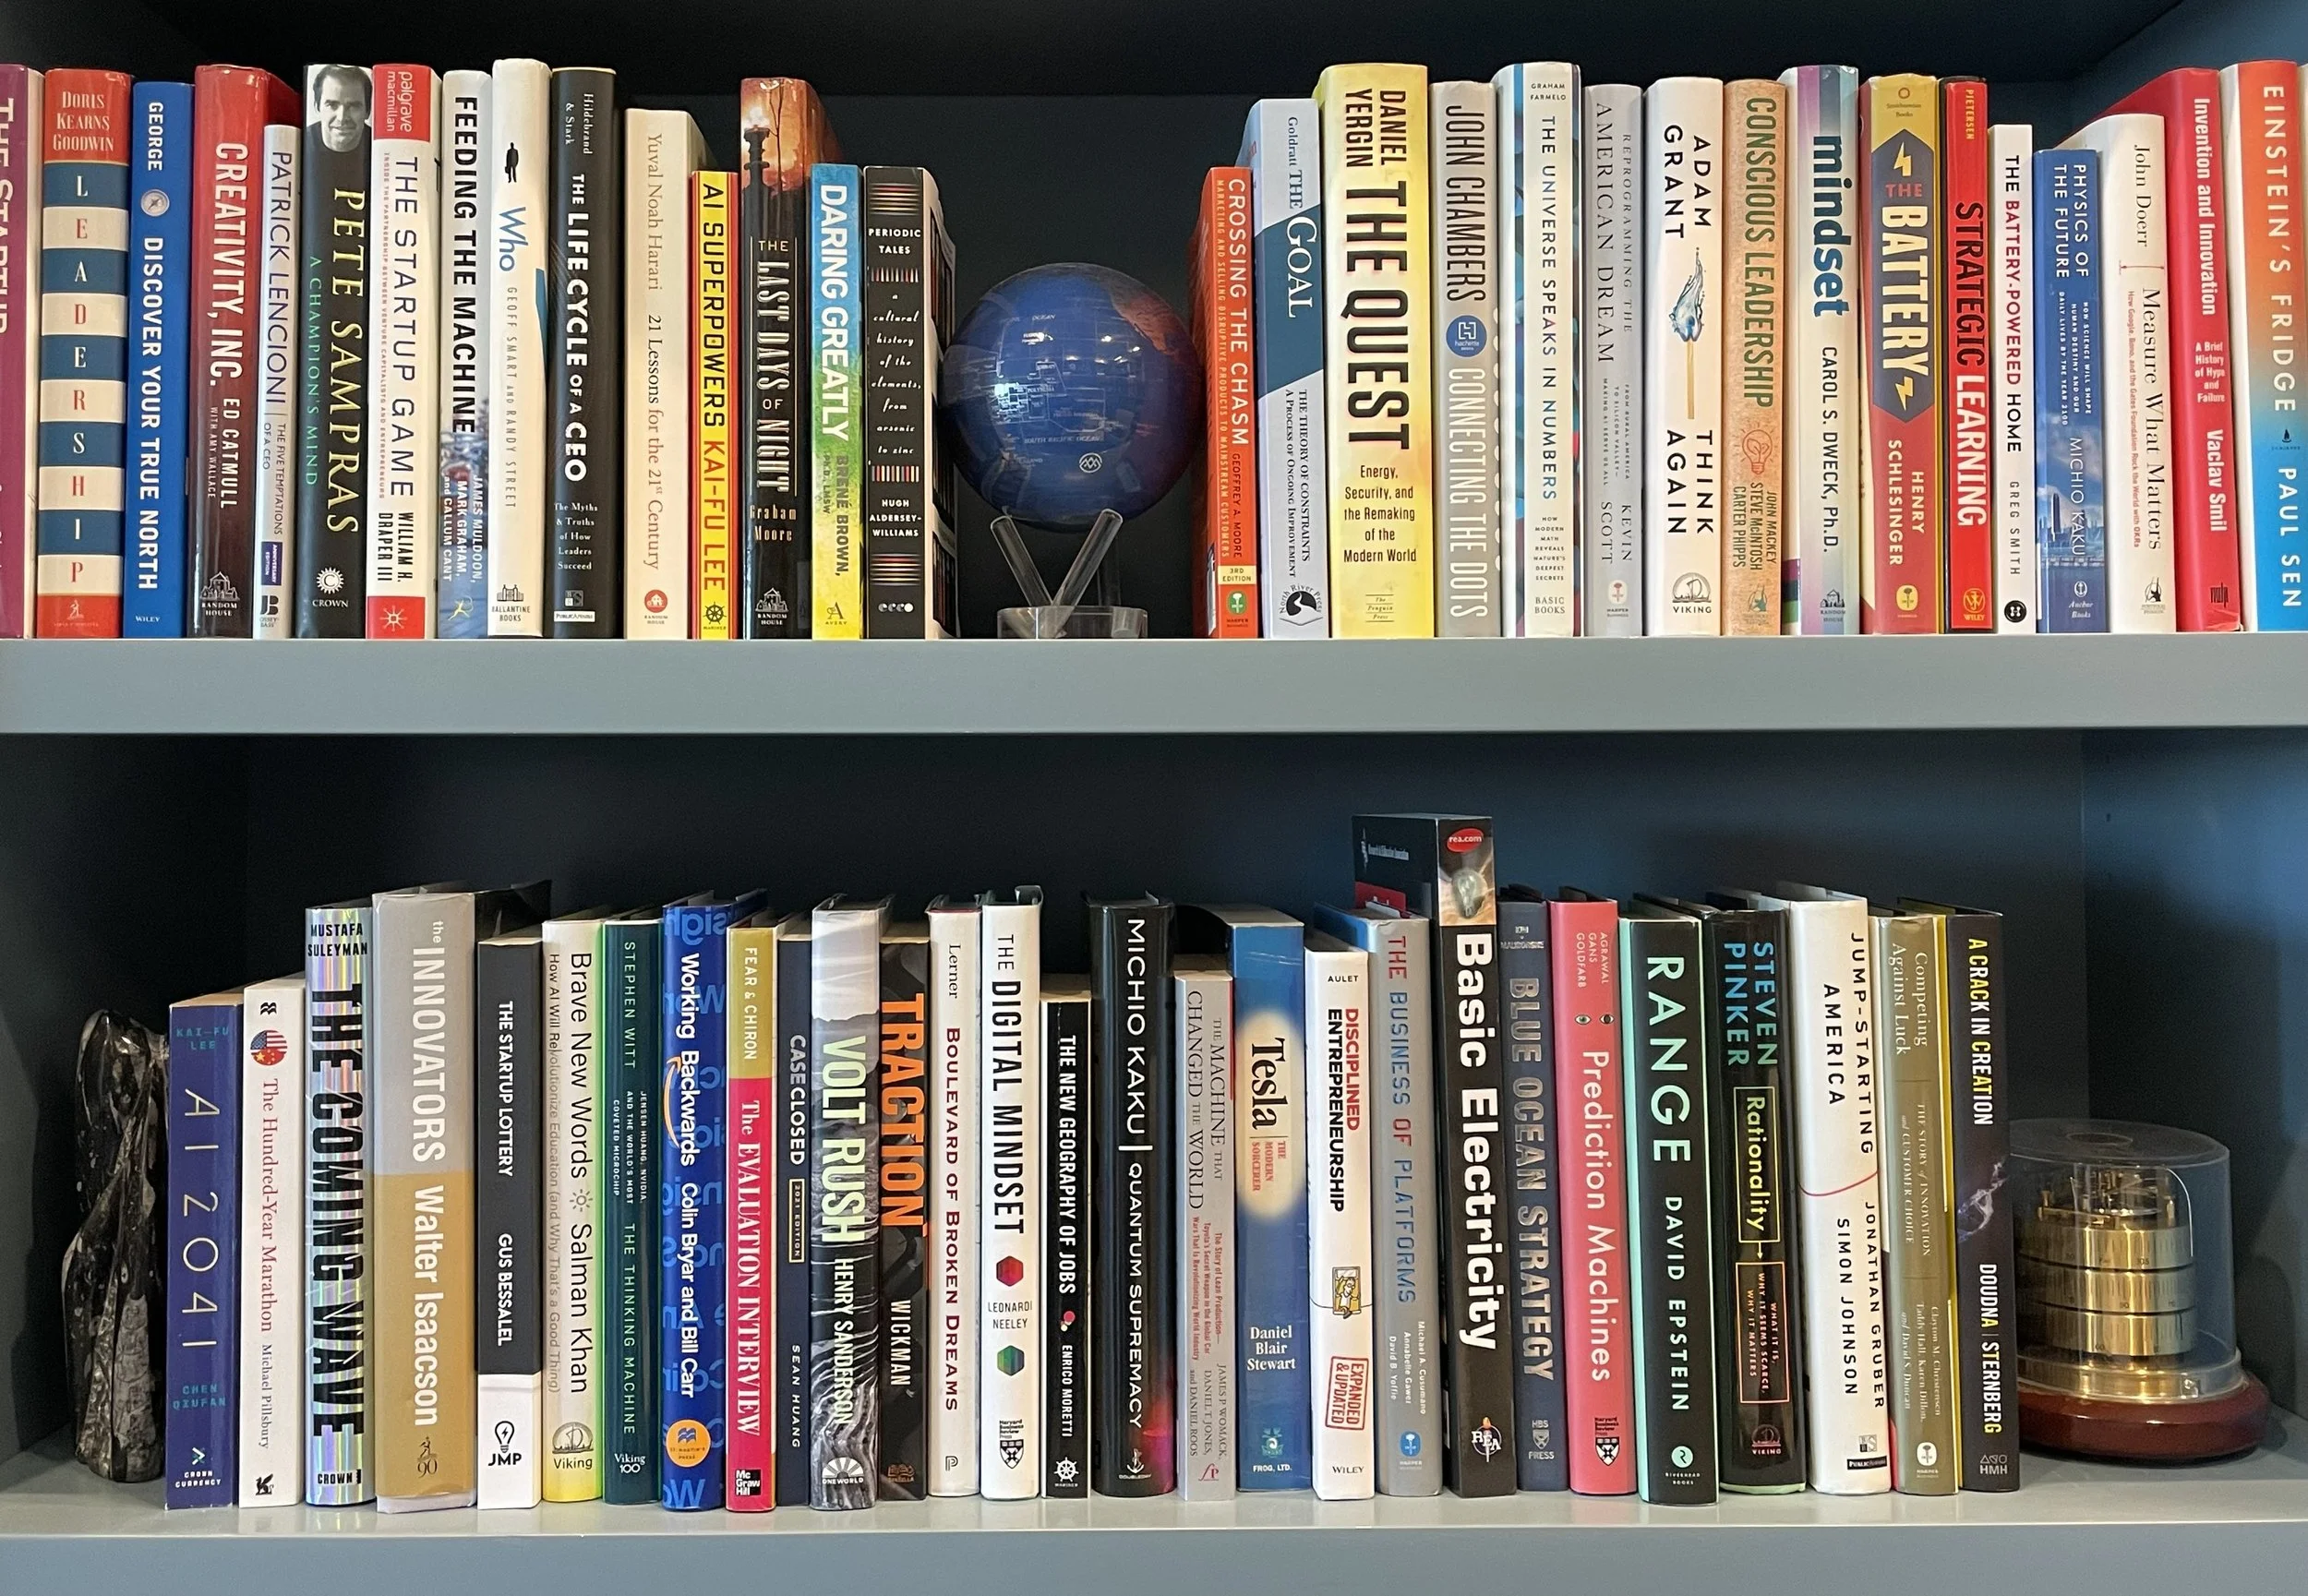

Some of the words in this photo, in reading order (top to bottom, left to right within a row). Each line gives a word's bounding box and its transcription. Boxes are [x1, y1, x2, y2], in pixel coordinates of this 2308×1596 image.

[57, 113, 109, 131] KEARNS
[63, 91, 104, 108] DORIS
[149, 102, 163, 170] GEORGE
[387, 71, 397, 131] macmillan
[397, 72, 415, 132] palgrave
[583, 94, 594, 153] Hildebrand
[1346, 89, 1373, 167] YERGIN
[1380, 90, 1406, 165] DANIEL
[1446, 106, 1485, 164] JOHN
[54, 134, 113, 151] GOODWIN
[454, 98, 477, 218] FEEDING
[648, 134, 663, 177] Yuval
[1289, 117, 1298, 166] Goldratt
[1597, 103, 1613, 249] AMERICAN
[1665, 126, 1684, 238] GRANT
[1694, 136, 1711, 226] ADAM
[1745, 98, 1776, 242] CONSCIOUS
[2134, 145, 2150, 186] John
[2264, 87, 2290, 272] EINSTEIN'S
[270, 152, 292, 260] PATRICK
[396, 157, 417, 213] THE
[572, 174, 584, 204] THE
[648, 185, 663, 228] Noah
[703, 184, 724, 208] AI
[1290, 170, 1303, 209] THE
[1346, 181, 1407, 272] THE
[1814, 136, 1852, 317] mindset
[2137, 197, 2151, 246] Doerr
[208, 143, 247, 318] CREATIVITY,
[310, 257, 321, 268] A
[332, 188, 365, 296] PETE
[454, 230, 475, 284] THE
[499, 207, 528, 271] Who
[568, 213, 588, 270] LIFE
[648, 234, 662, 290] Harari
[822, 186, 847, 298] DARING
[869, 229, 920, 237] PERIODIC
[879, 246, 910, 254] TALES
[1229, 179, 1246, 297] CROSSING
[1287, 217, 1316, 318] GOAL
[1447, 177, 1485, 301] CHAMBERS
[143, 238, 162, 355] DISCOVER
[393, 230, 416, 380] STARTUP
[567, 280, 588, 366] CYCLE
[703, 222, 725, 427] SUPERPOWERS
[1598, 267, 1614, 361] DREAM
[1882, 206, 1929, 376] BATTERY
[1955, 203, 1984, 366] STRATEGIC
[210, 330, 243, 386] INC.
[266, 273, 289, 402] LENCIONI
[307, 278, 321, 414] CHAMPION'S
[453, 297, 475, 432] MACHINE
[1231, 308, 1247, 352] THE
[1340, 290, 1409, 450] QUEST
[1744, 253, 1774, 407] LEADERSHIP
[2272, 295, 2295, 411] FRIDGE
[141, 366, 161, 427] YOUR
[570, 375, 582, 396] OF
[570, 402, 582, 414] A
[822, 307, 848, 440] GREATLY
[1232, 363, 1248, 444] CHASM
[306, 426, 318, 485] MIND
[327, 321, 362, 532] SAMPRAS
[391, 399, 414, 496] GAME
[565, 422, 586, 481] CEO
[1957, 376, 1986, 525] LEARNING
[2207, 429, 2224, 486] Vaclav
[140, 438, 160, 499] TRUE
[703, 439, 725, 532] KAI-FU
[1667, 430, 1687, 533] AGAIN
[1697, 430, 1713, 533] THINK
[2010, 482, 2019, 517] GREG
[2070, 438, 2084, 503] MICHIO
[138, 510, 158, 588] NORTH
[2010, 528, 2020, 574] SMITH
[2071, 510, 2087, 555] KAKU
[2209, 494, 2227, 531] Smil
[704, 545, 725, 590] LEE
[1449, 835, 1483, 844] rea.com
[308, 942, 367, 956] SULEYMAN
[311, 923, 363, 936] MUSTAFA
[433, 921, 443, 942] the
[998, 934, 1014, 970] THE
[1388, 936, 1407, 978] THE
[1969, 939, 1988, 949] A
[625, 942, 635, 1017] STEPHEN
[676, 954, 701, 1038] Working
[949, 945, 960, 998] Lerner
[1127, 919, 1145, 1035] MICHIO
[1457, 934, 1495, 1066] Basic
[1725, 943, 1749, 1065] PINKER
[1754, 942, 1777, 1064] STEVEN
[1888, 943, 1908, 1006] Against
[1912, 953, 1930, 1046] Competing
[1969, 955, 1989, 1012] CRACK
[312, 983, 363, 1072] THE
[413, 948, 445, 1161] INNOVATORS
[625, 1028, 635, 1068] WITT
[992, 981, 1022, 1091] DIGITAL
[1389, 992, 1410, 1104] BUSINESS
[1510, 978, 1541, 1062] BLUE
[1648, 957, 1690, 1161] RANGE
[1824, 984, 1845, 1104] AMERICA
[1895, 1015, 1910, 1054] Luck
[1971, 1018, 1990, 1034] IN
[680, 1051, 700, 1166] Backwards
[823, 1036, 866, 1123] VOLT
[881, 993, 924, 1228] TRACTION
[1127, 1048, 1145, 1134] KAKU
[1252, 1038, 1288, 1129] Tesla
[1328, 1009, 1343, 1211] ENTREPRENEURSHIP
[1346, 1009, 1359, 1130] DISCIPLINED
[1972, 1042, 1992, 1124] CREATION
[742, 1100, 759, 1134] The
[1393, 1119, 1412, 1146] OF
[1513, 1077, 1546, 1189] OCEAN
[1583, 1052, 1613, 1208] Prediction
[313, 1092, 364, 1280] COMING
[821, 1138, 866, 1242] RUSH
[993, 1106, 1024, 1233] MINDSET
[1747, 1098, 1771, 1230] Rationality
[415, 1185, 443, 1282] Walter
[738, 1144, 760, 1287] EVALUATION
[1394, 1160, 1415, 1302] PLATFORMS
[1460, 1088, 1504, 1349] Electricity
[571, 1224, 593, 1316] Salman
[1518, 1206, 1554, 1380] STRATEGY
[1588, 1225, 1618, 1380] Machines
[262, 1345, 272, 1390] Michael
[313, 1300, 364, 1436] WAVE
[415, 1293, 443, 1425] Isaacson
[571, 1328, 593, 1392] Khan
[738, 1297, 760, 1435] INTERVIEW
[1062, 1345, 1072, 1385] ENRICO
[1247, 1359, 1295, 1370] Stewart
[1251, 1326, 1292, 1338] Daniel
[1256, 1341, 1287, 1354] Blair
[258, 1396, 272, 1446] Pillsbury
[1062, 1389, 1072, 1436] MORETTI
[488, 1453, 522, 1466] JMP
[554, 1458, 592, 1470] Viking
[1980, 1465, 2007, 1474] HMH
